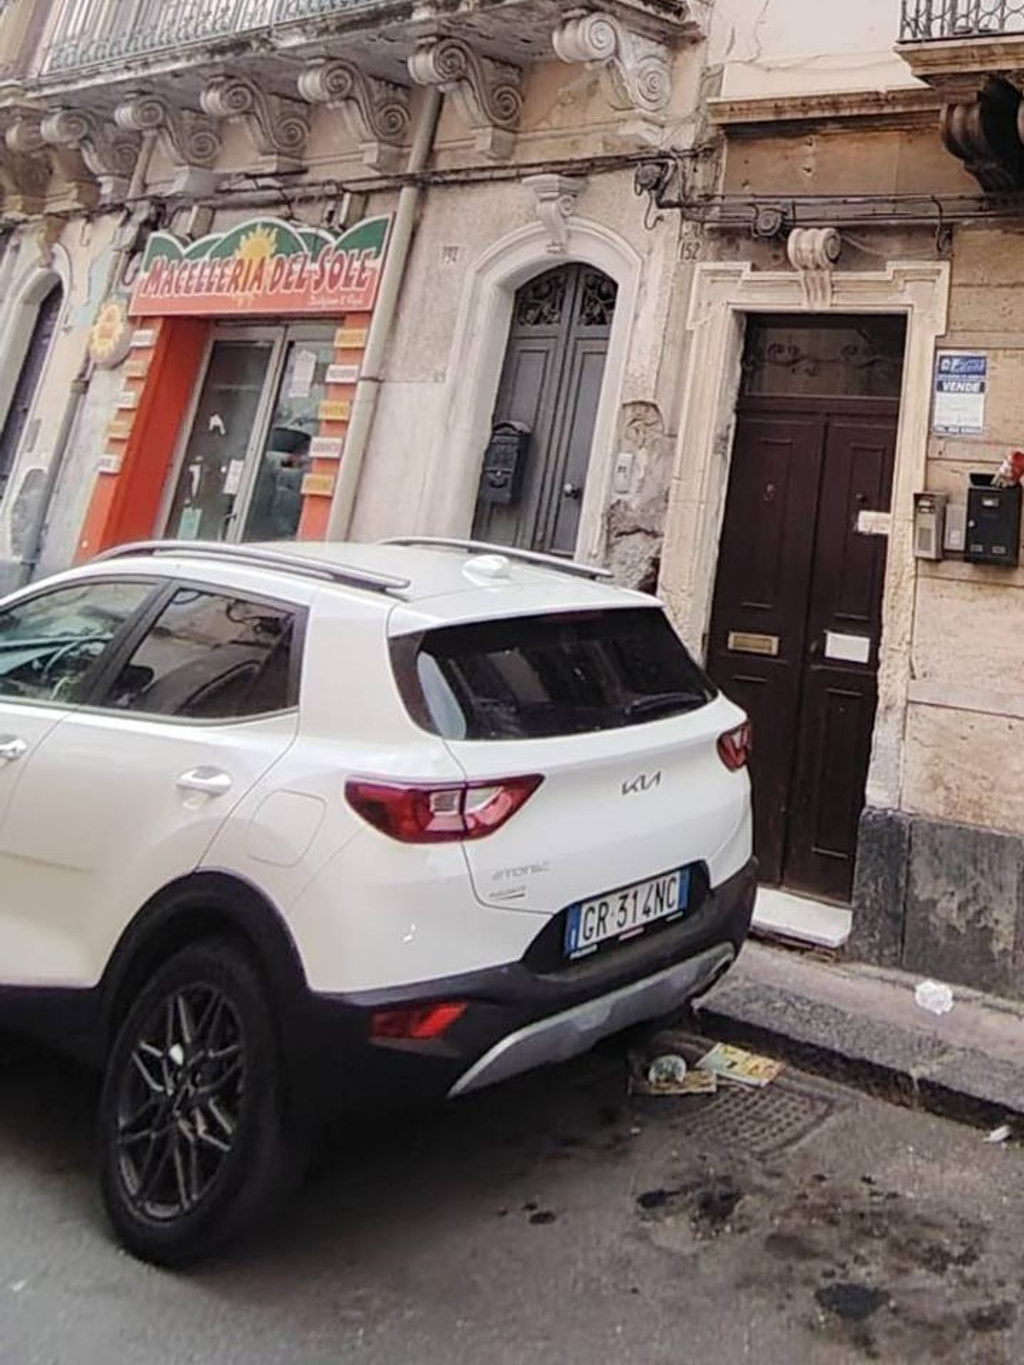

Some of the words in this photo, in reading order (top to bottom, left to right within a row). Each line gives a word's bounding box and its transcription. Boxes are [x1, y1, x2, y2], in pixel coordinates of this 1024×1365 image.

[139, 254, 267, 298] MACELLERIA
[266, 250, 309, 295] DEL
[311, 244, 377, 295] SOLE
[942, 381, 981, 393] VENDE
[622, 770, 661, 796] KIA
[583, 901, 609, 941] GR
[617, 876, 677, 928] 314NC
